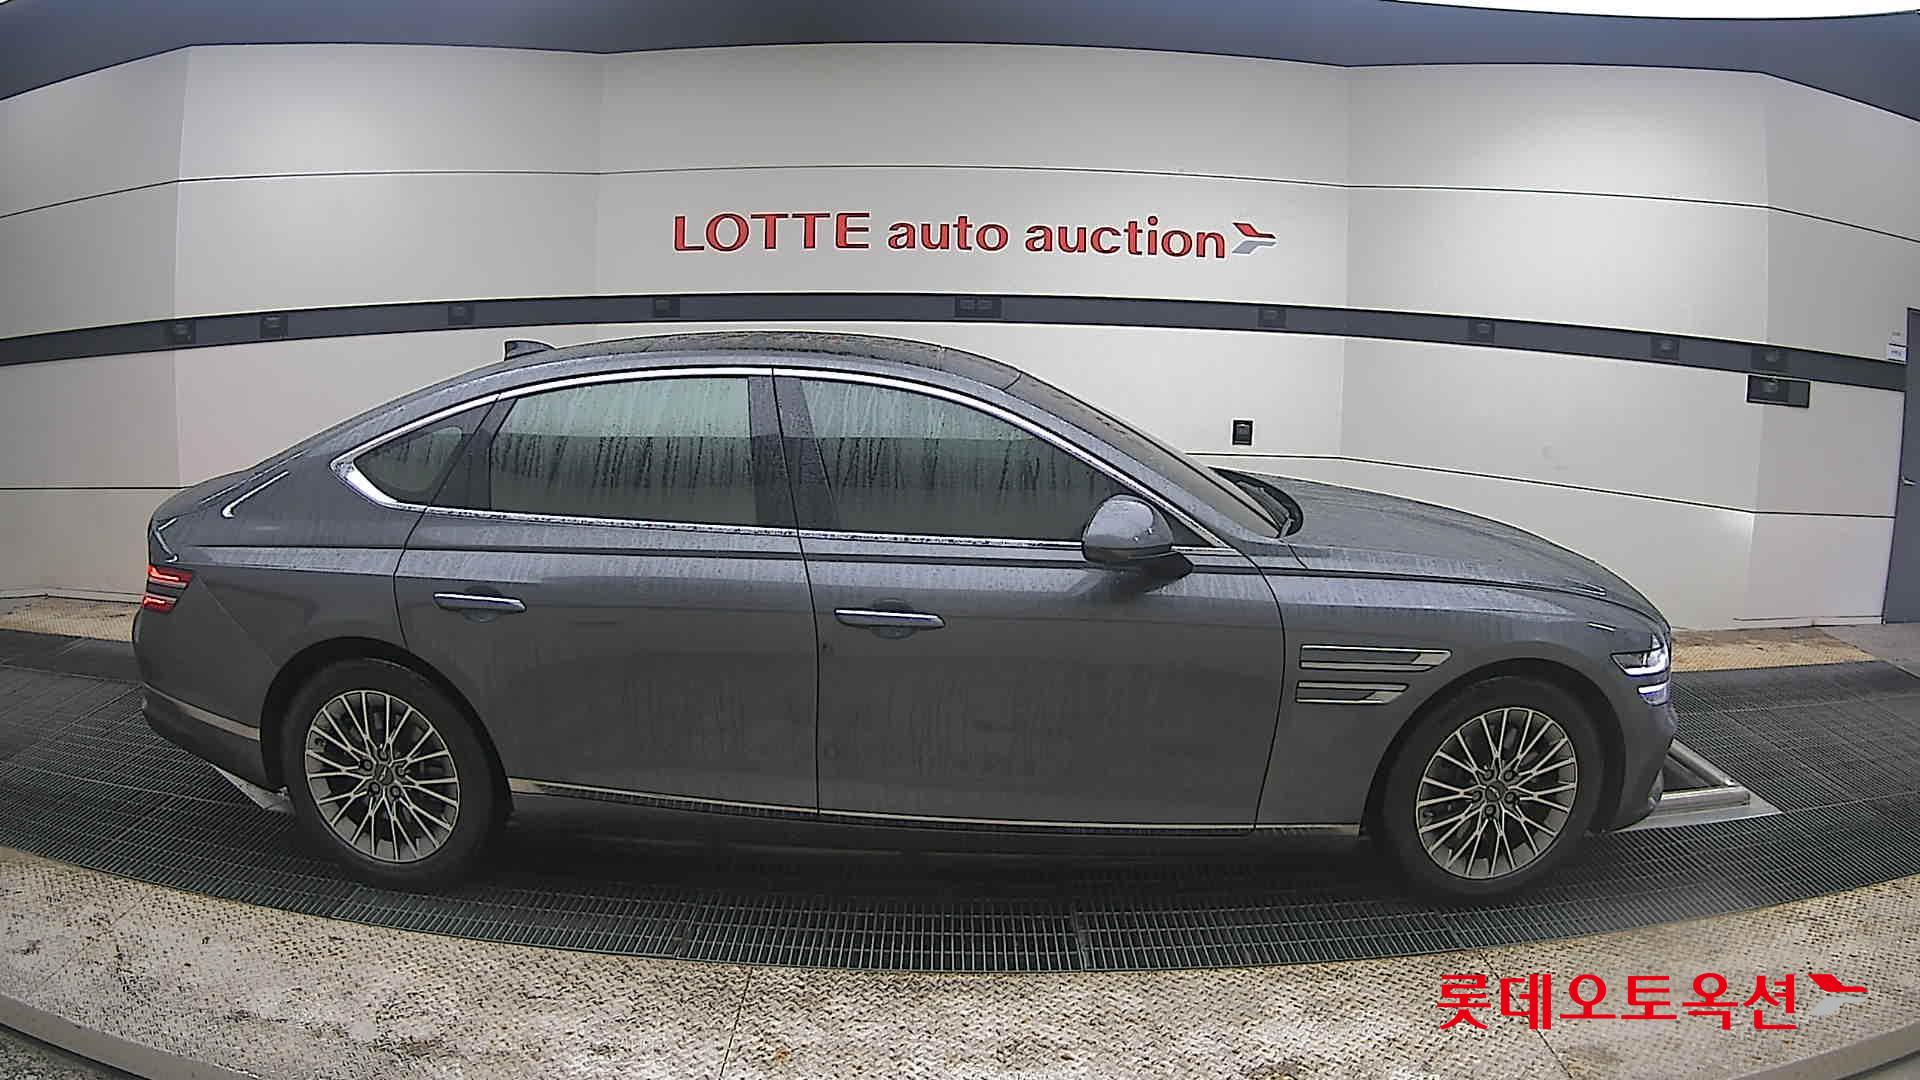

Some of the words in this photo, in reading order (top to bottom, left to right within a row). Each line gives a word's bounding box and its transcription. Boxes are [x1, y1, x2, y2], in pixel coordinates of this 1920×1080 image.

[673, 212, 870, 252] LOTTE
[889, 215, 1009, 250] auto
[1026, 216, 1226, 257] auction
